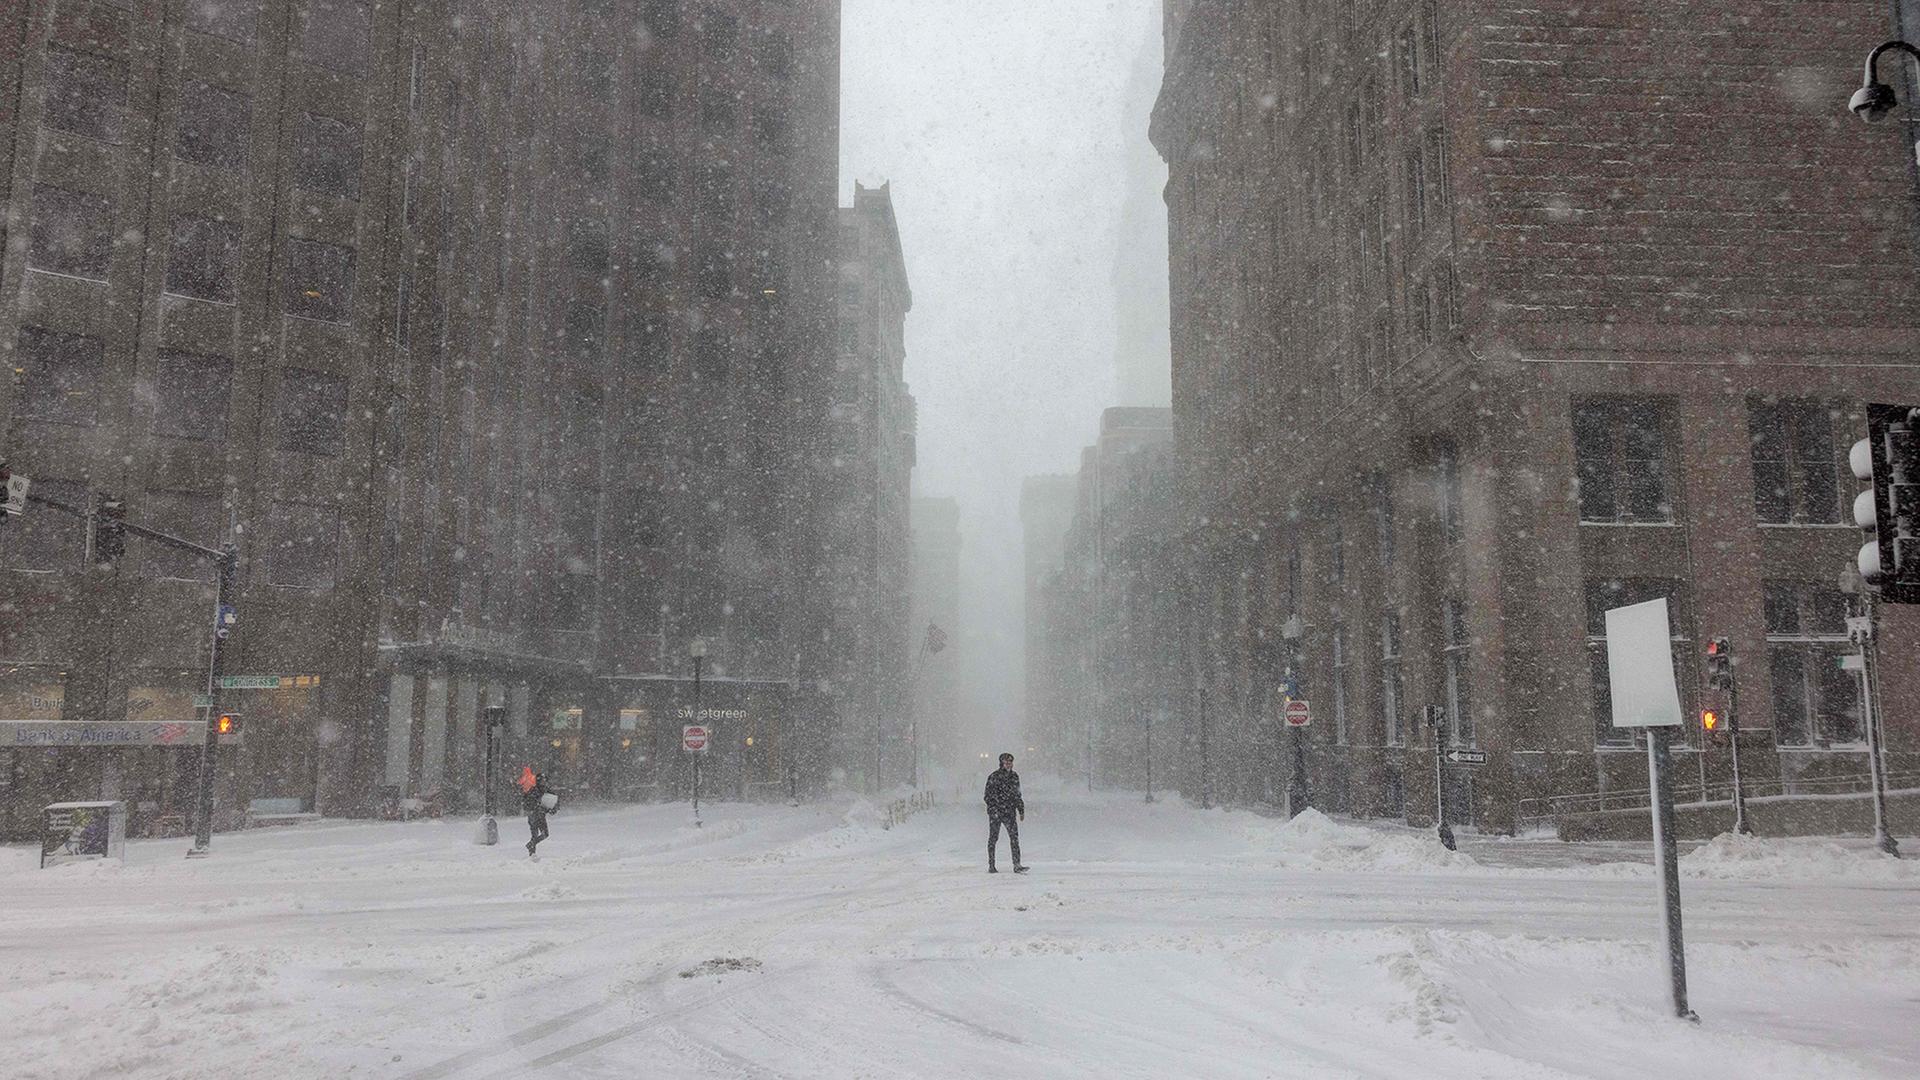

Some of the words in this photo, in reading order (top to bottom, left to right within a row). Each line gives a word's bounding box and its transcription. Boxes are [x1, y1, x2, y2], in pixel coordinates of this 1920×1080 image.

[12, 481, 24, 491] NO
[678, 708, 747, 720] swetgreen
[16, 728, 55, 743] Bank
[80, 728, 142, 743] America
